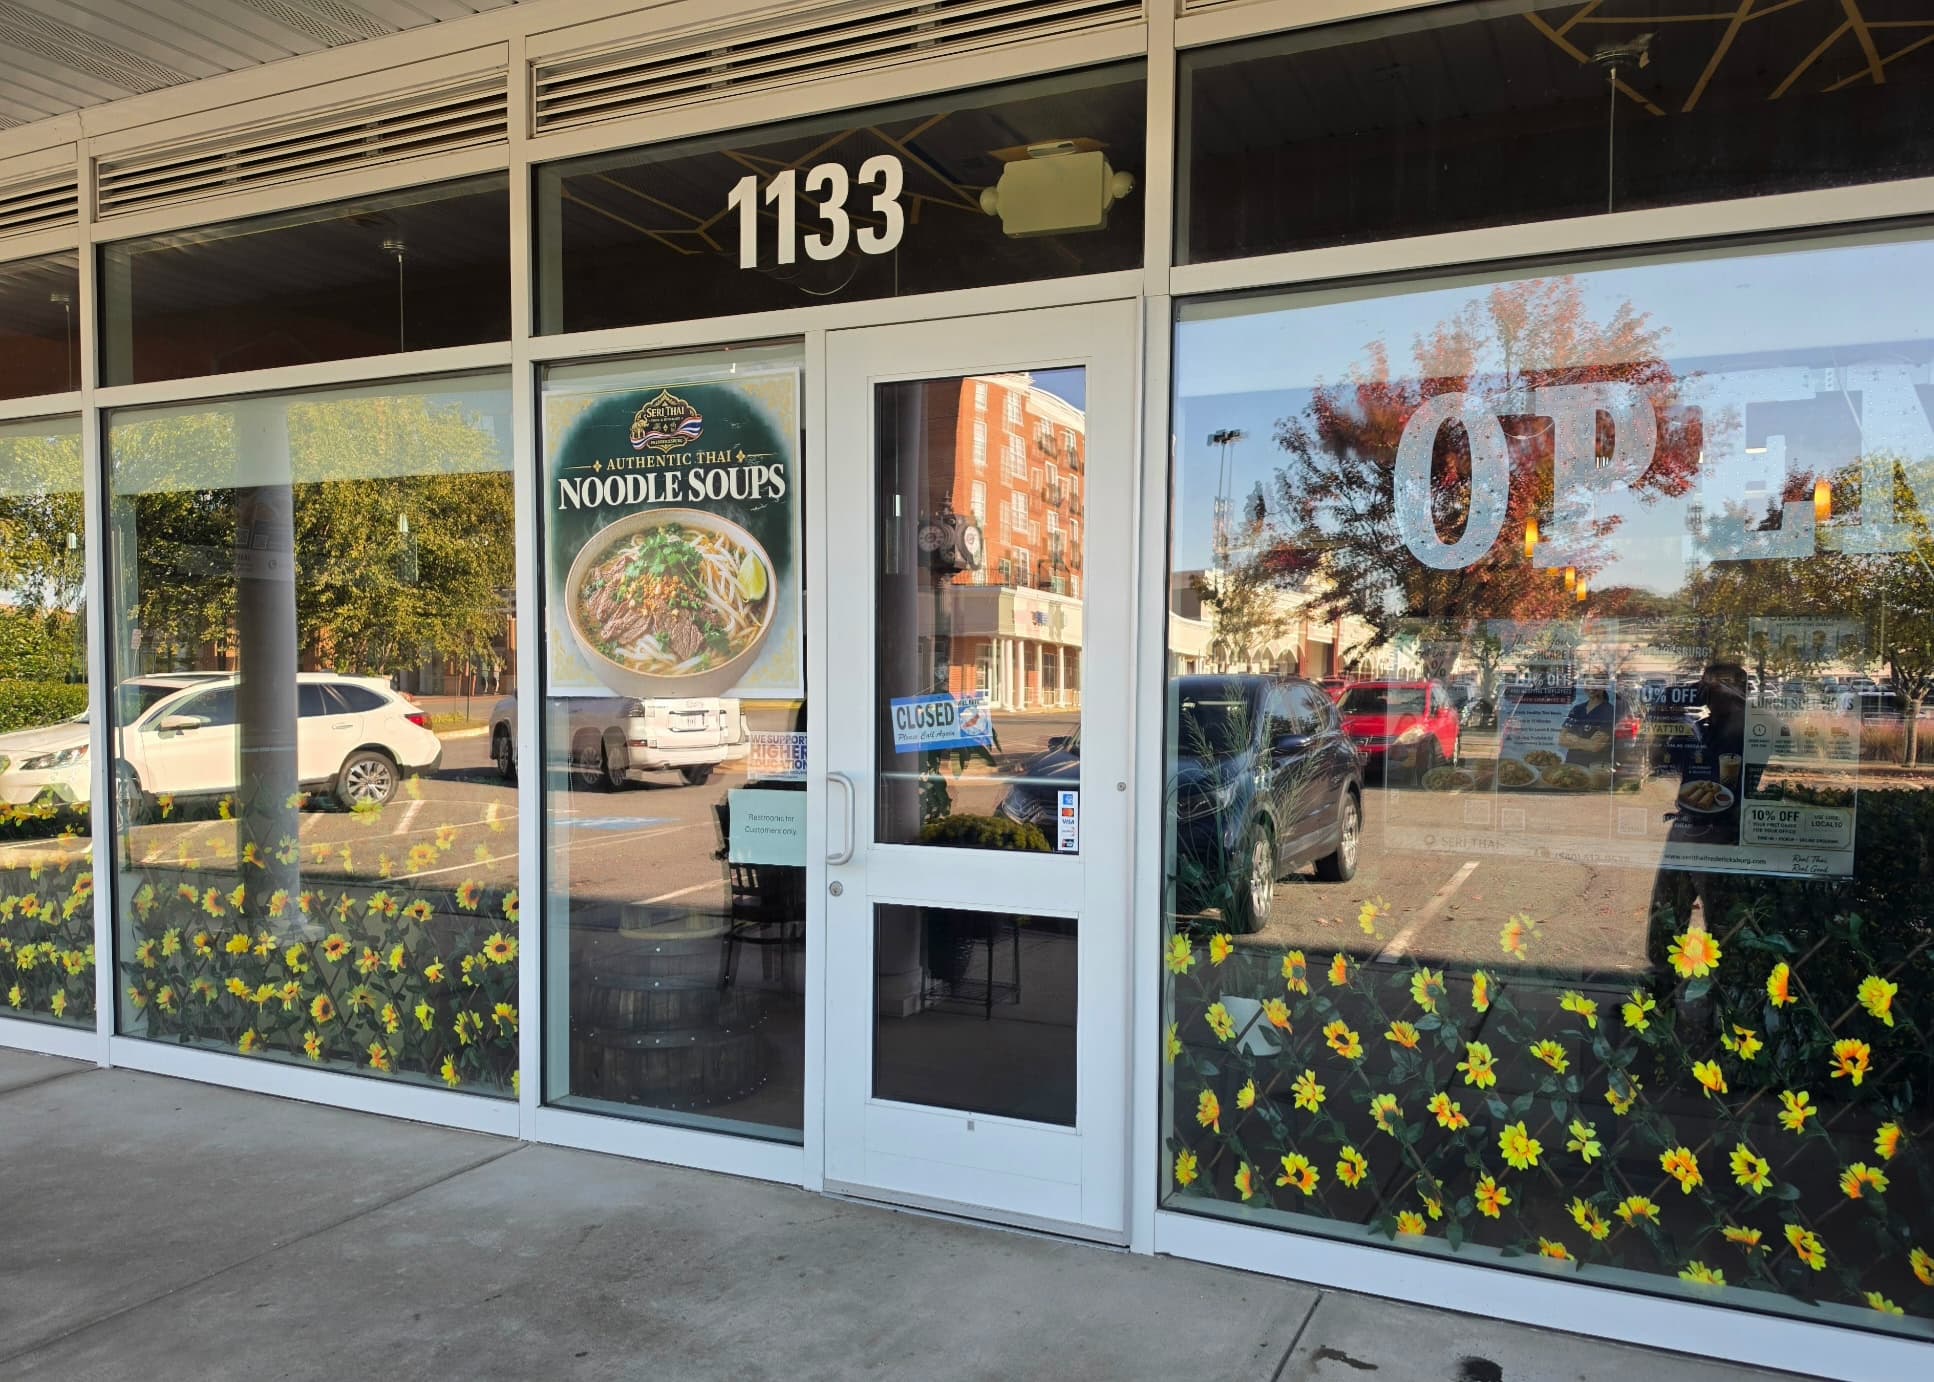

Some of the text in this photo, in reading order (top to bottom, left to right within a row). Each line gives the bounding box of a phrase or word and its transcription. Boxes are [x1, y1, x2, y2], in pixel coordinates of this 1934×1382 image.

[727, 154, 905, 270] 1133
[646, 406, 685, 418] SERI THAI
[607, 450, 732, 470] AUTHENTIC THAI
[558, 464, 786, 511] NOODLE SOUPS
[1671, 688, 1698, 704] OFF
[1751, 696, 1785, 710] LUNCH
[896, 702, 955, 731] CLOSED
[751, 735, 766, 744] WE
[920, 730, 936, 740] Call
[1752, 810, 1800, 822] 10% OFF
[745, 825, 781, 834] Customers
[1441, 837, 1499, 849] SERI THAI
